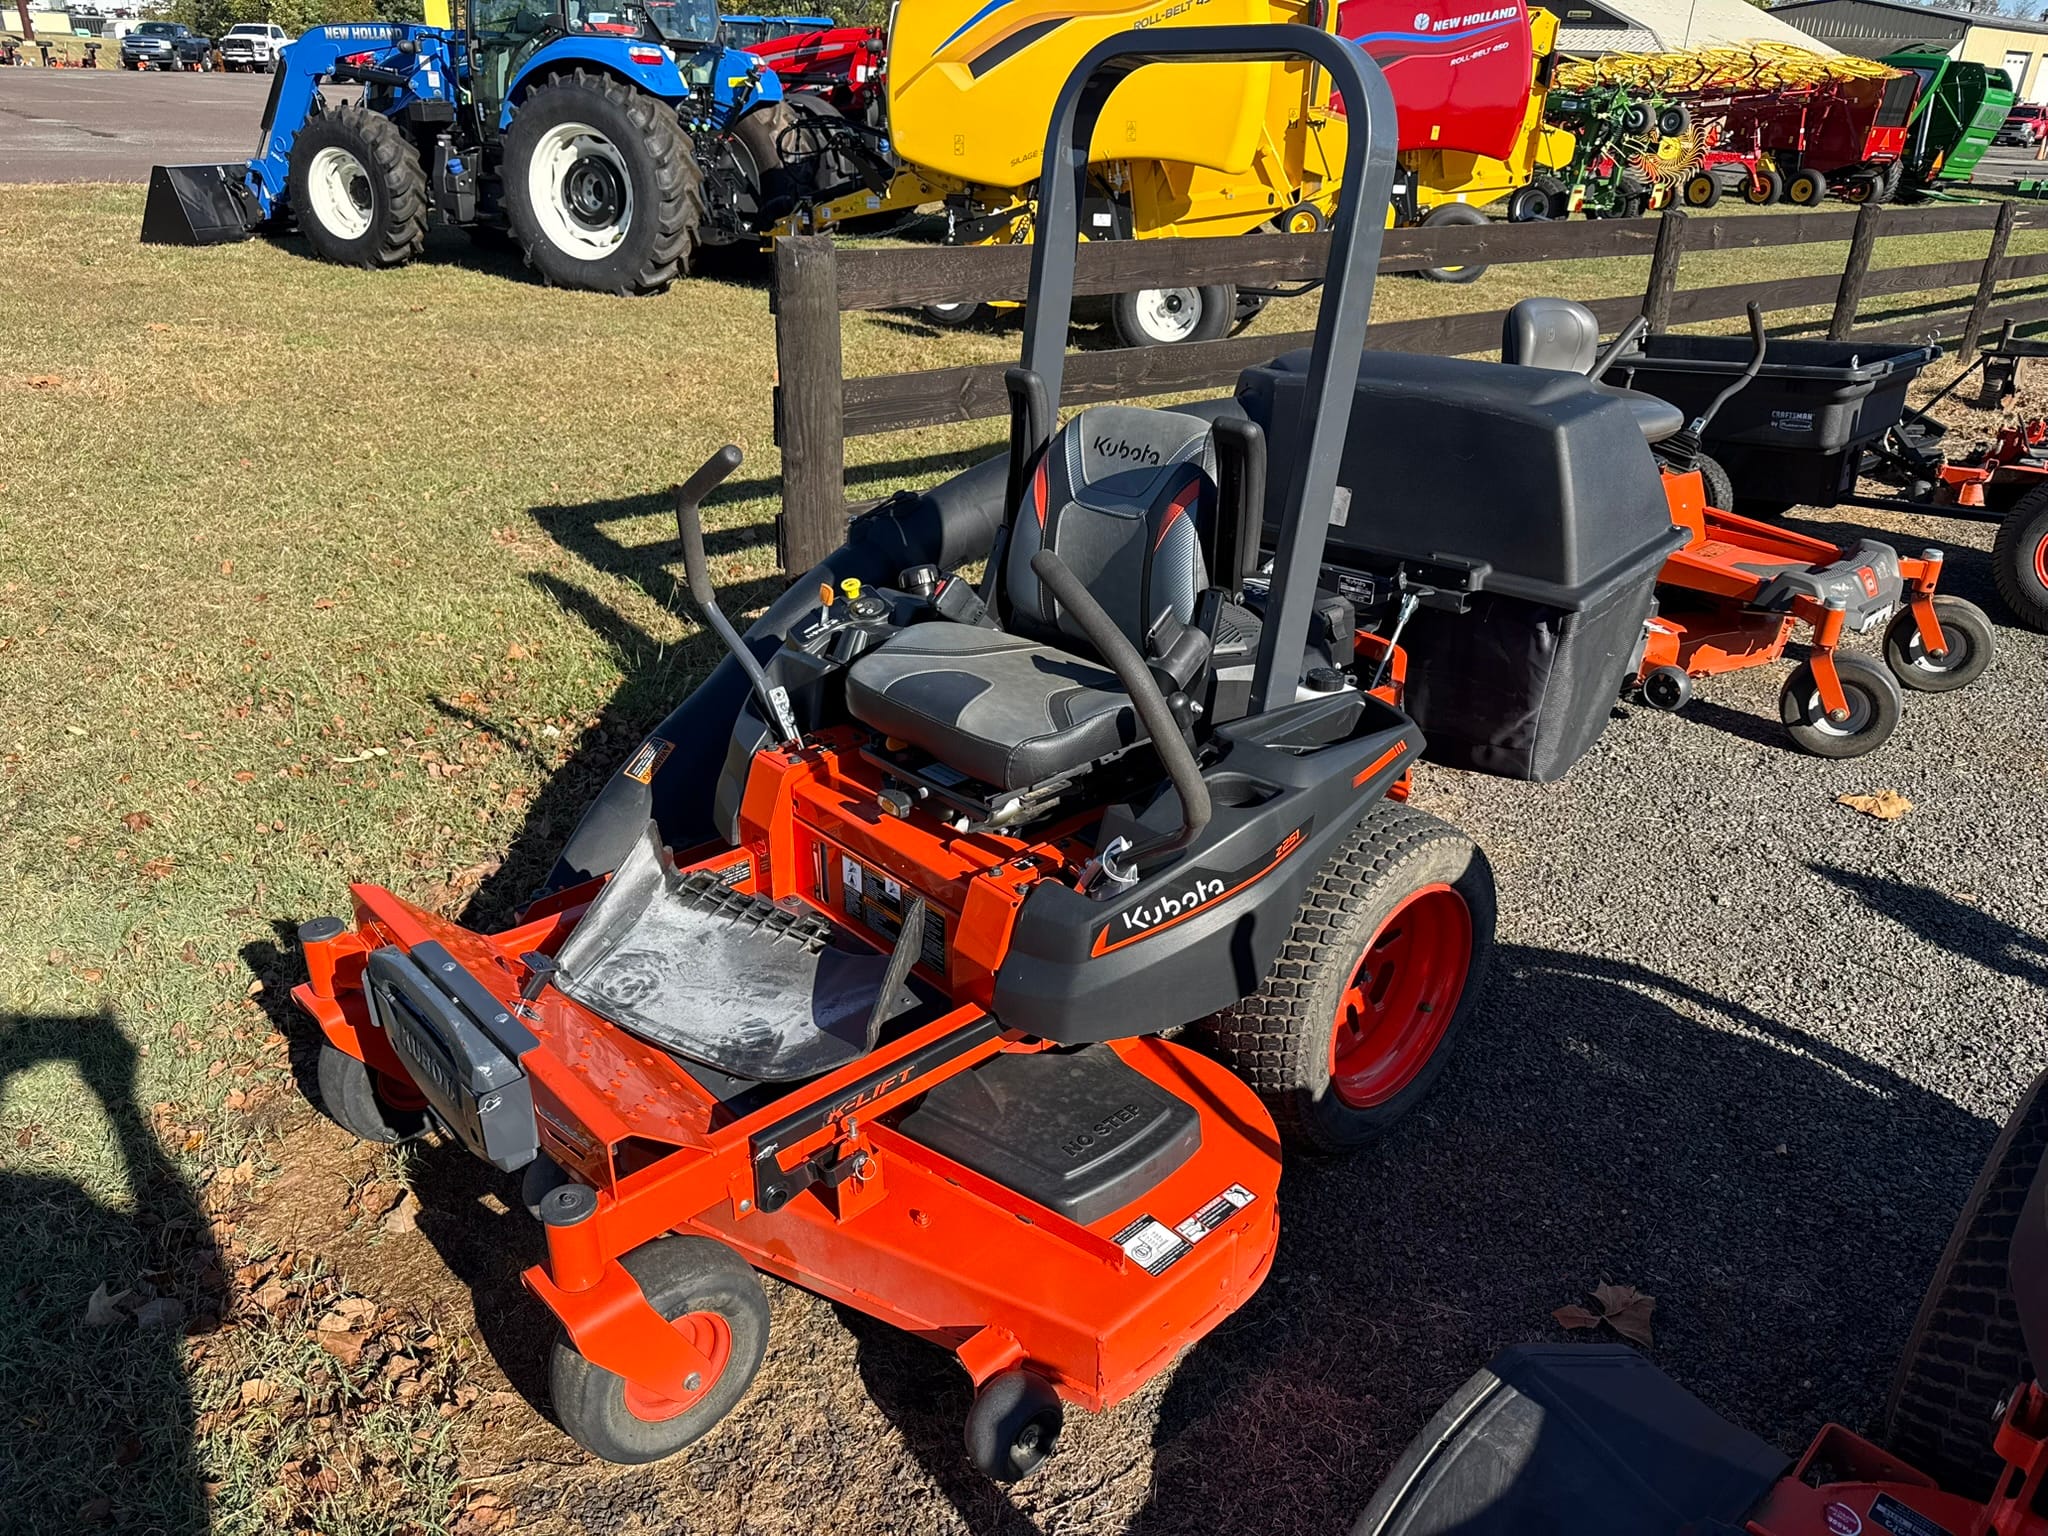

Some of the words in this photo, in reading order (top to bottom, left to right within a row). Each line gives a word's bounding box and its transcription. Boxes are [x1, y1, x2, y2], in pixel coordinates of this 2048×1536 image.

[1134, 1, 1193, 30] ROLL-BELT
[1432, 17, 1461, 32] NEW
[1463, 7, 1518, 26] HOLLAND
[324, 26, 349, 39] NEW
[351, 27, 402, 40] HOLLAND
[1450, 47, 1491, 66] ROLL-BELT
[1010, 149, 1038, 167] SILAGE
[1093, 435, 1160, 465] Kubota
[1122, 878, 1225, 929] Kubota
[827, 1065, 916, 1124] K-LIFT
[1062, 1134, 1095, 1158] NO
[1093, 1104, 1140, 1137] STEP
